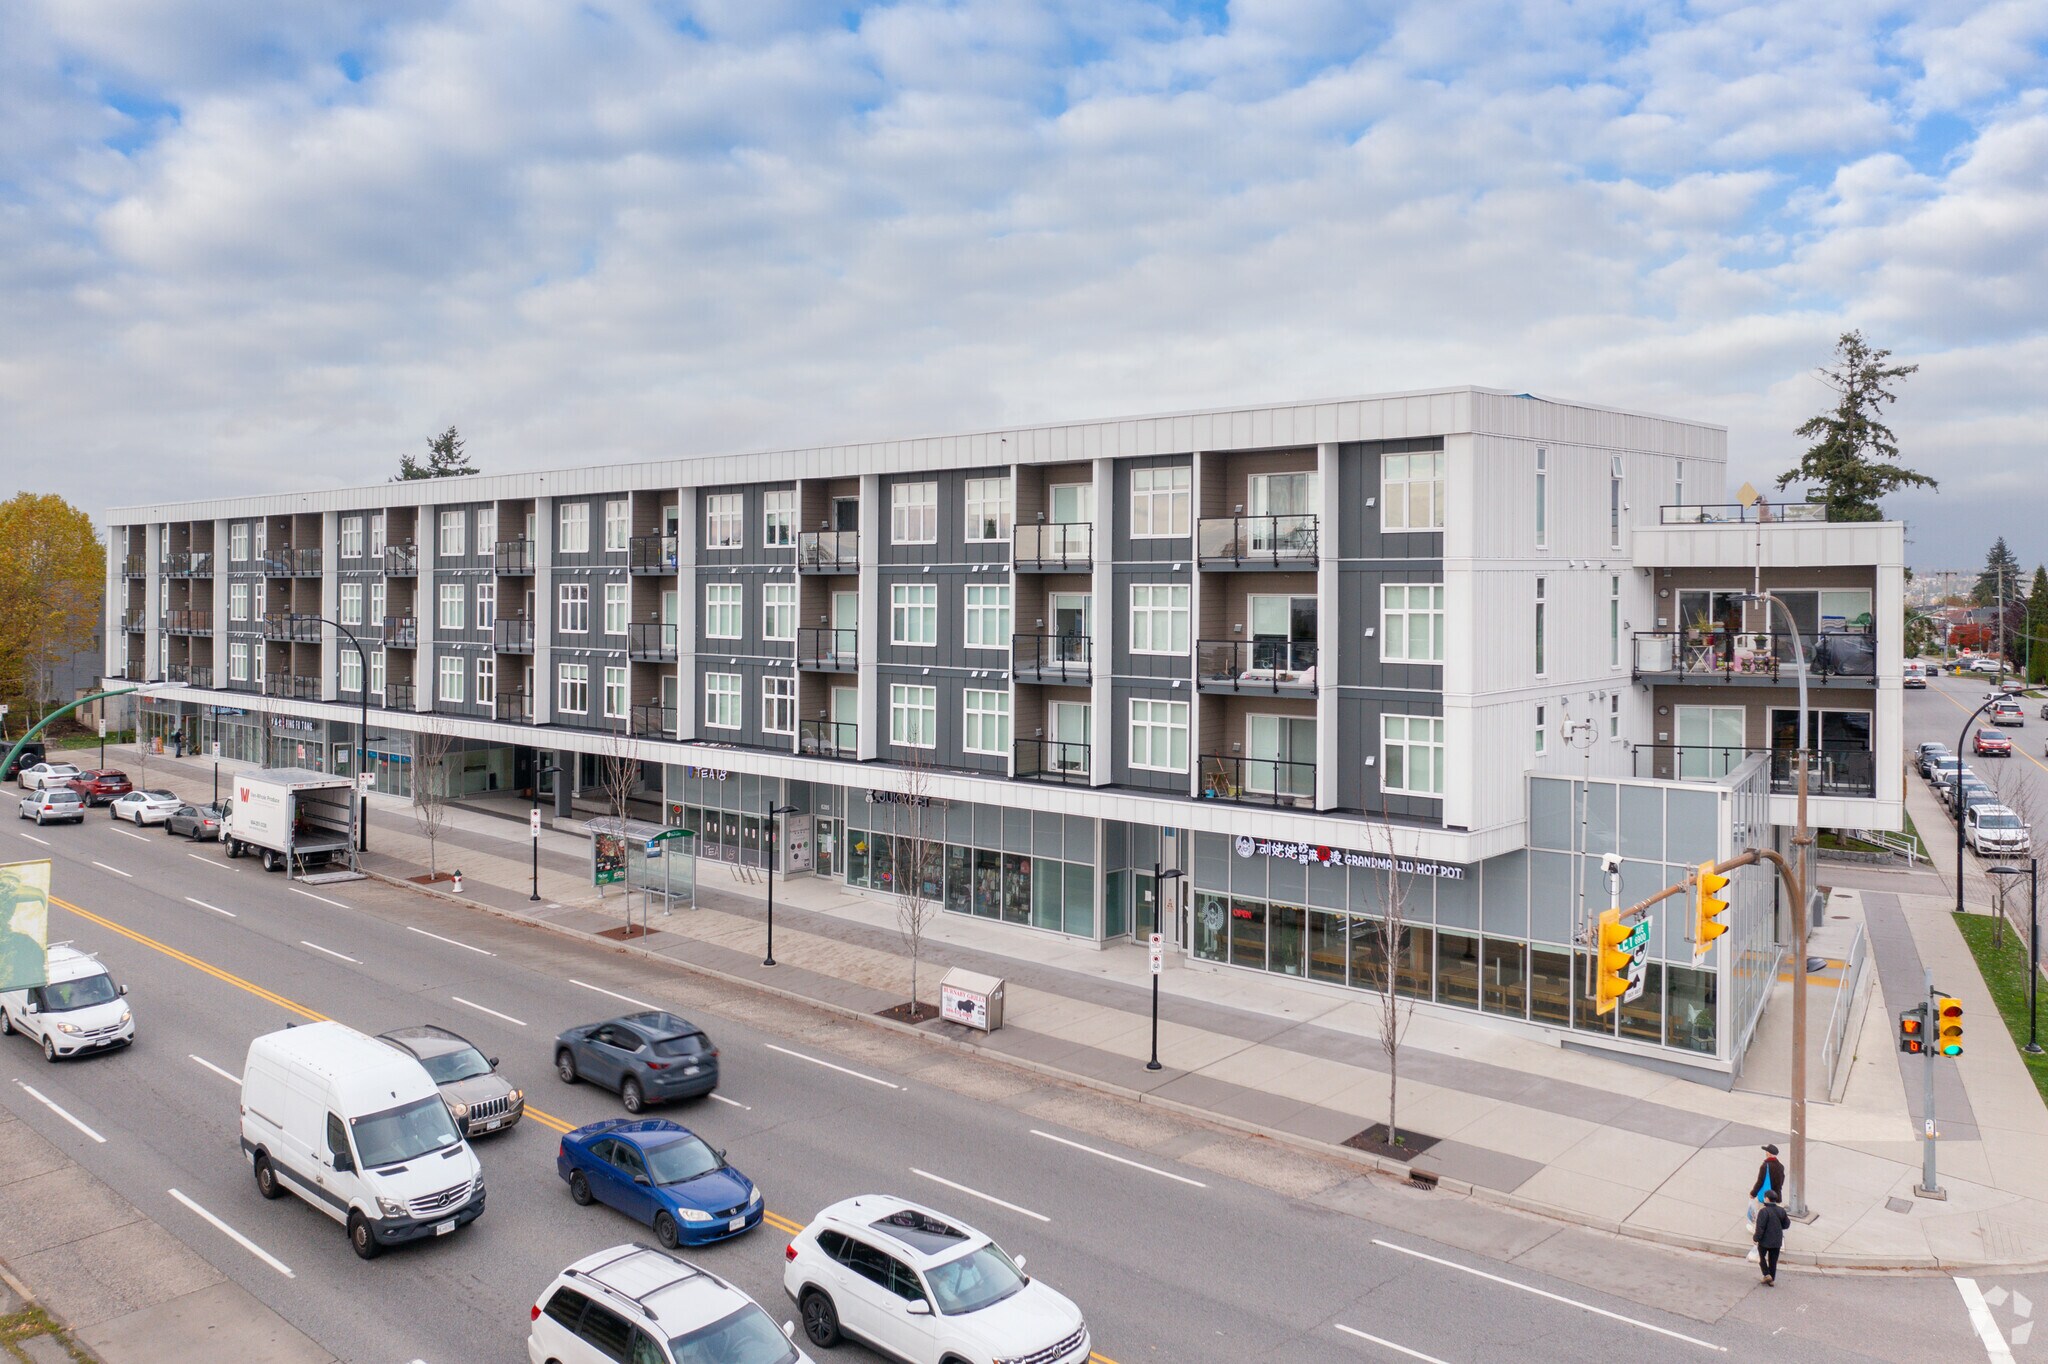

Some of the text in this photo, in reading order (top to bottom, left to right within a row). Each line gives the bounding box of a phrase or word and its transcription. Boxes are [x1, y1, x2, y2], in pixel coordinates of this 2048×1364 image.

[1344, 853, 1463, 880] GRANDMA LIU HOT POT
[1232, 908, 1252, 919] OPEN
[944, 987, 966, 998] BURNABY
